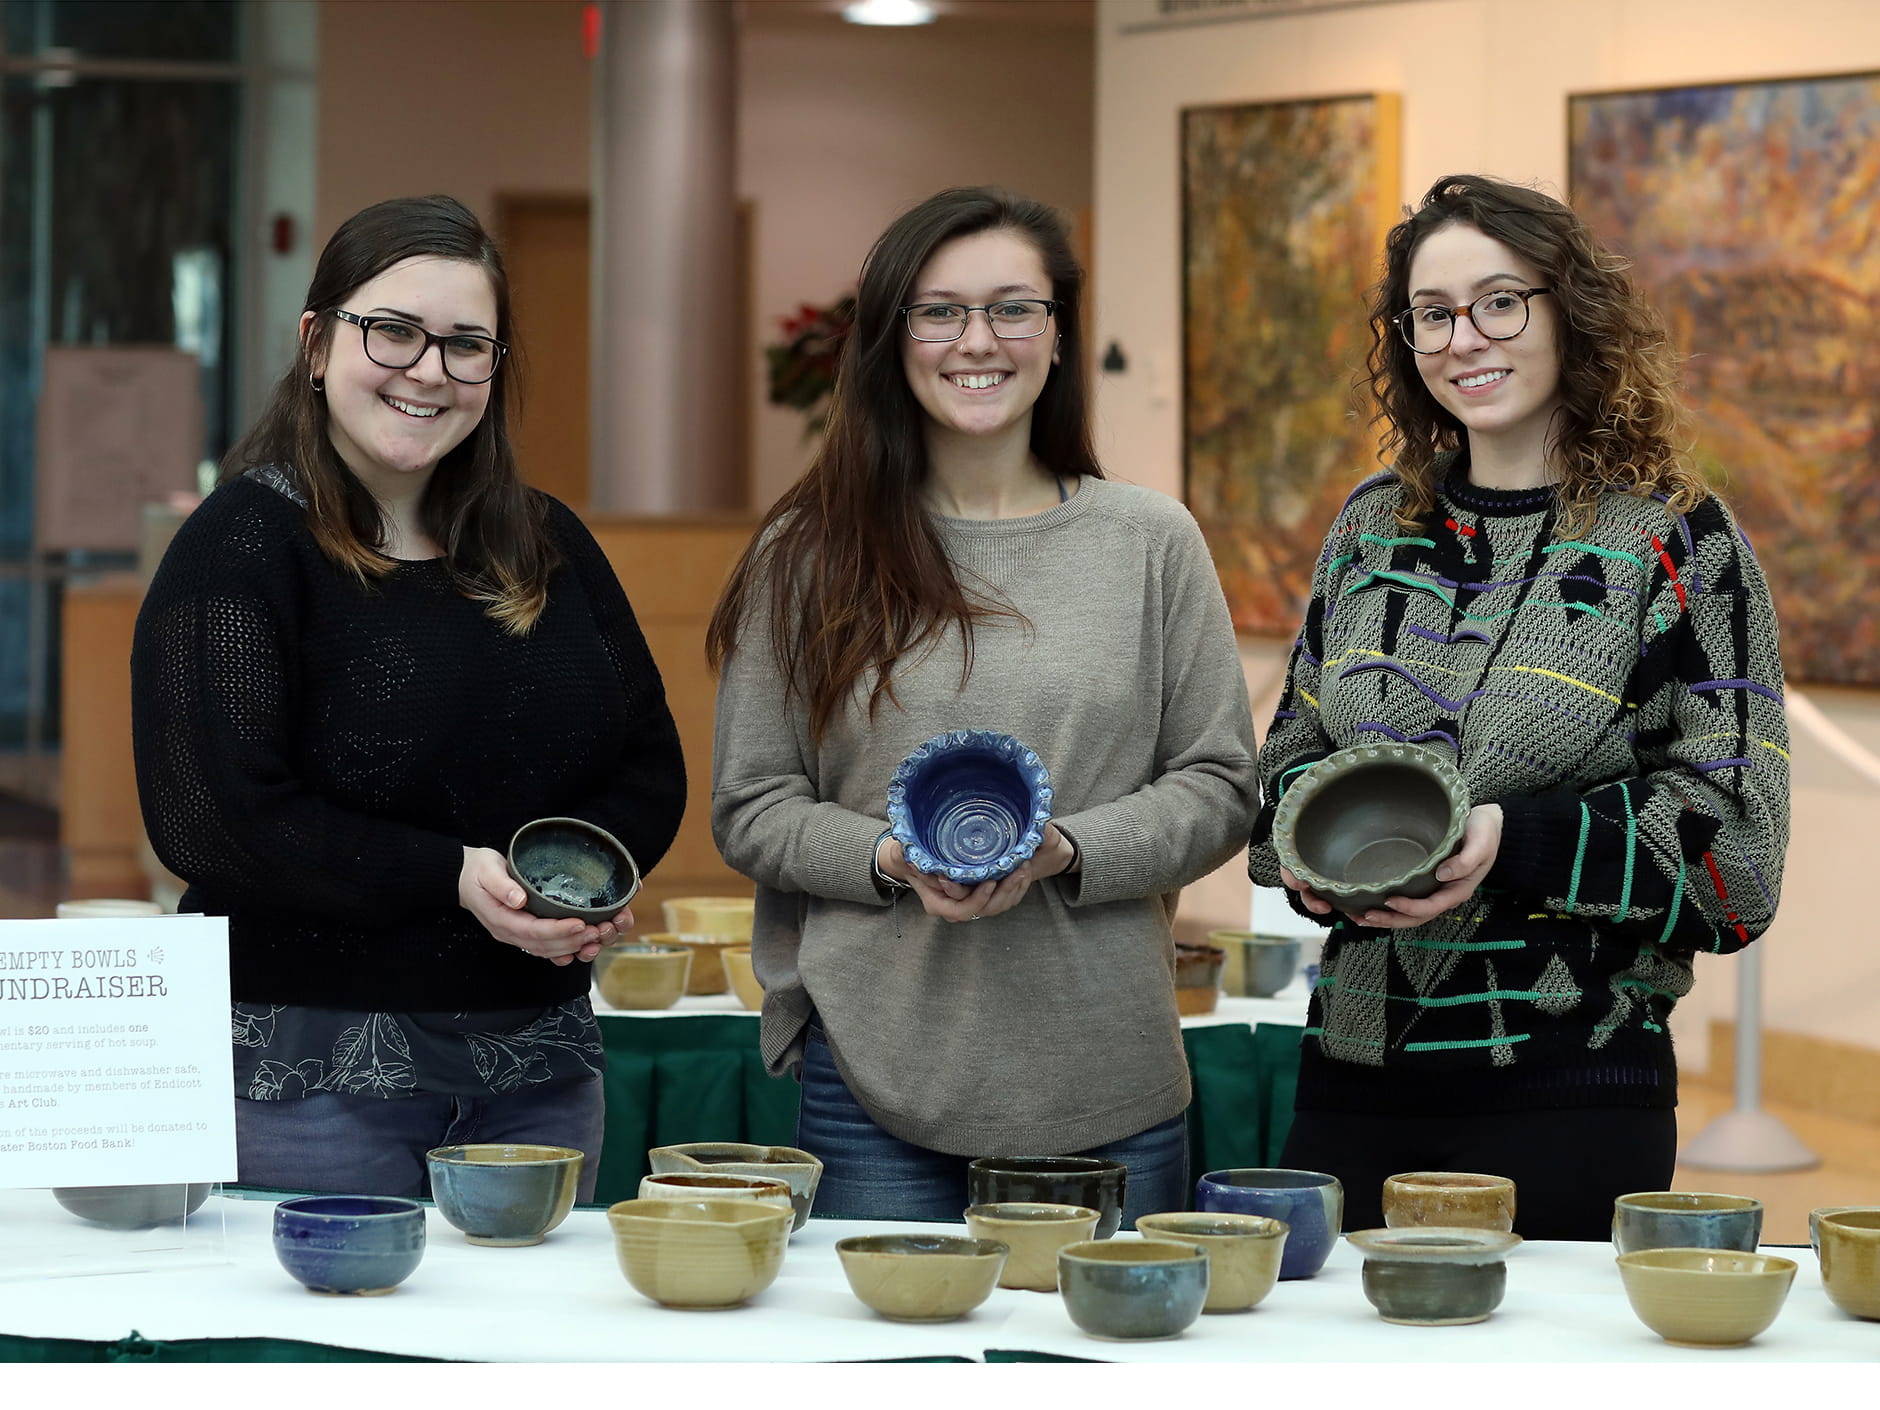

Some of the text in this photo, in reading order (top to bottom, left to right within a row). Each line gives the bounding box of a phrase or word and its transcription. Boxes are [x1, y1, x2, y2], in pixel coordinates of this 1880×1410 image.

[0, 949, 137, 970] EMPTY BOWLS
[27, 1025, 49, 1035] $20
[52, 1025, 74, 1034] and
[78, 1024, 126, 1033] includes
[129, 1025, 148, 1033] one
[46, 1040, 91, 1051] serving
[95, 1039, 104, 1047] of
[108, 1038, 127, 1047] hot
[14, 1070, 77, 1079] microwave
[81, 1068, 102, 1077] and
[105, 1065, 171, 1076] dishwasher
[2, 1079, 201, 1094] handmade by members of Endicott
[8, 1099, 28, 1109] Art
[15, 1128, 27, 1137] of
[29, 1126, 47, 1136] the
[51, 1125, 102, 1137] proceeds
[105, 1123, 128, 1134] will
[131, 1123, 144, 1133] be
[147, 1122, 192, 1132] donated
[196, 1122, 207, 1130] to
[28, 1141, 66, 1151] Boston
[71, 1139, 97, 1149] Food
[102, 1137, 135, 1149] Bank!
